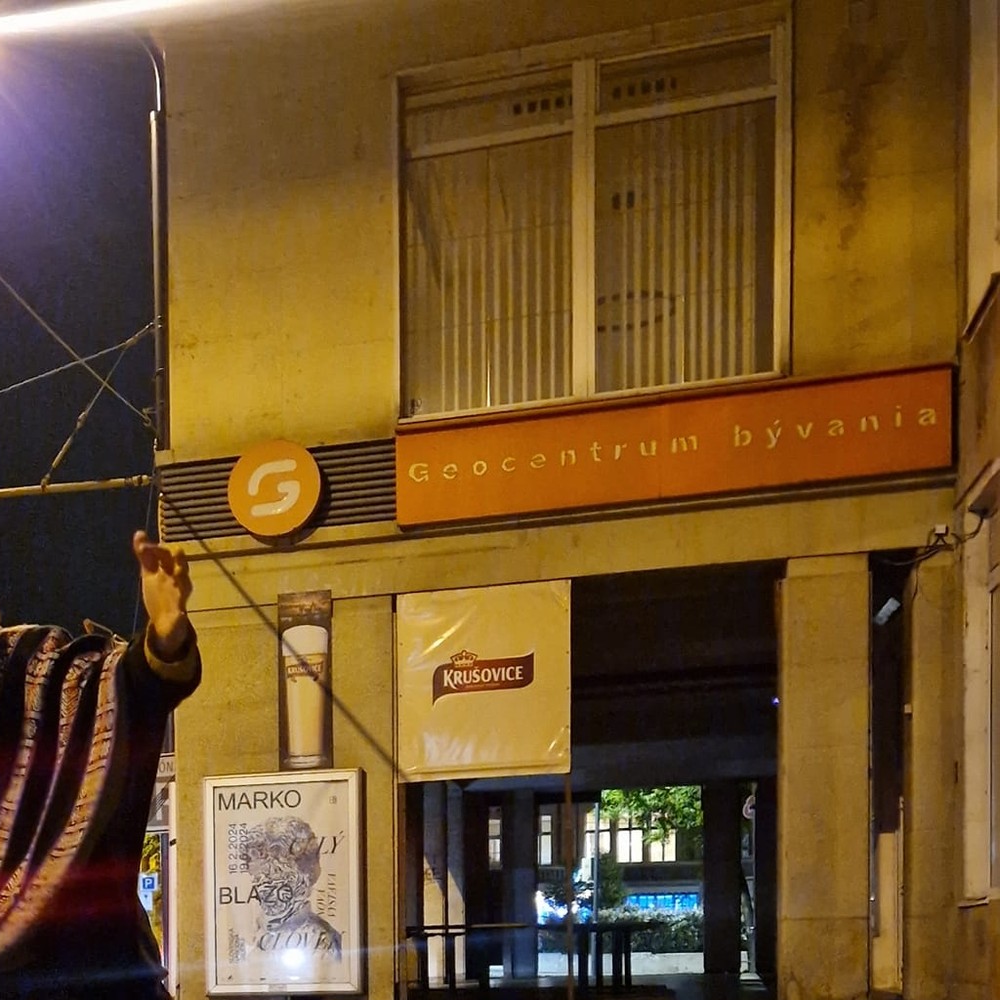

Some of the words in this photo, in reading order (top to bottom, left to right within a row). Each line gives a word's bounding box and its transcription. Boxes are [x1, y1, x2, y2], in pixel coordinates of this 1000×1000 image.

[408, 435, 698, 483] Geocentrum
[734, 405, 937, 449] bývania
[443, 665, 524, 690] KRUŠOVICE
[218, 789, 302, 811] MARKO
